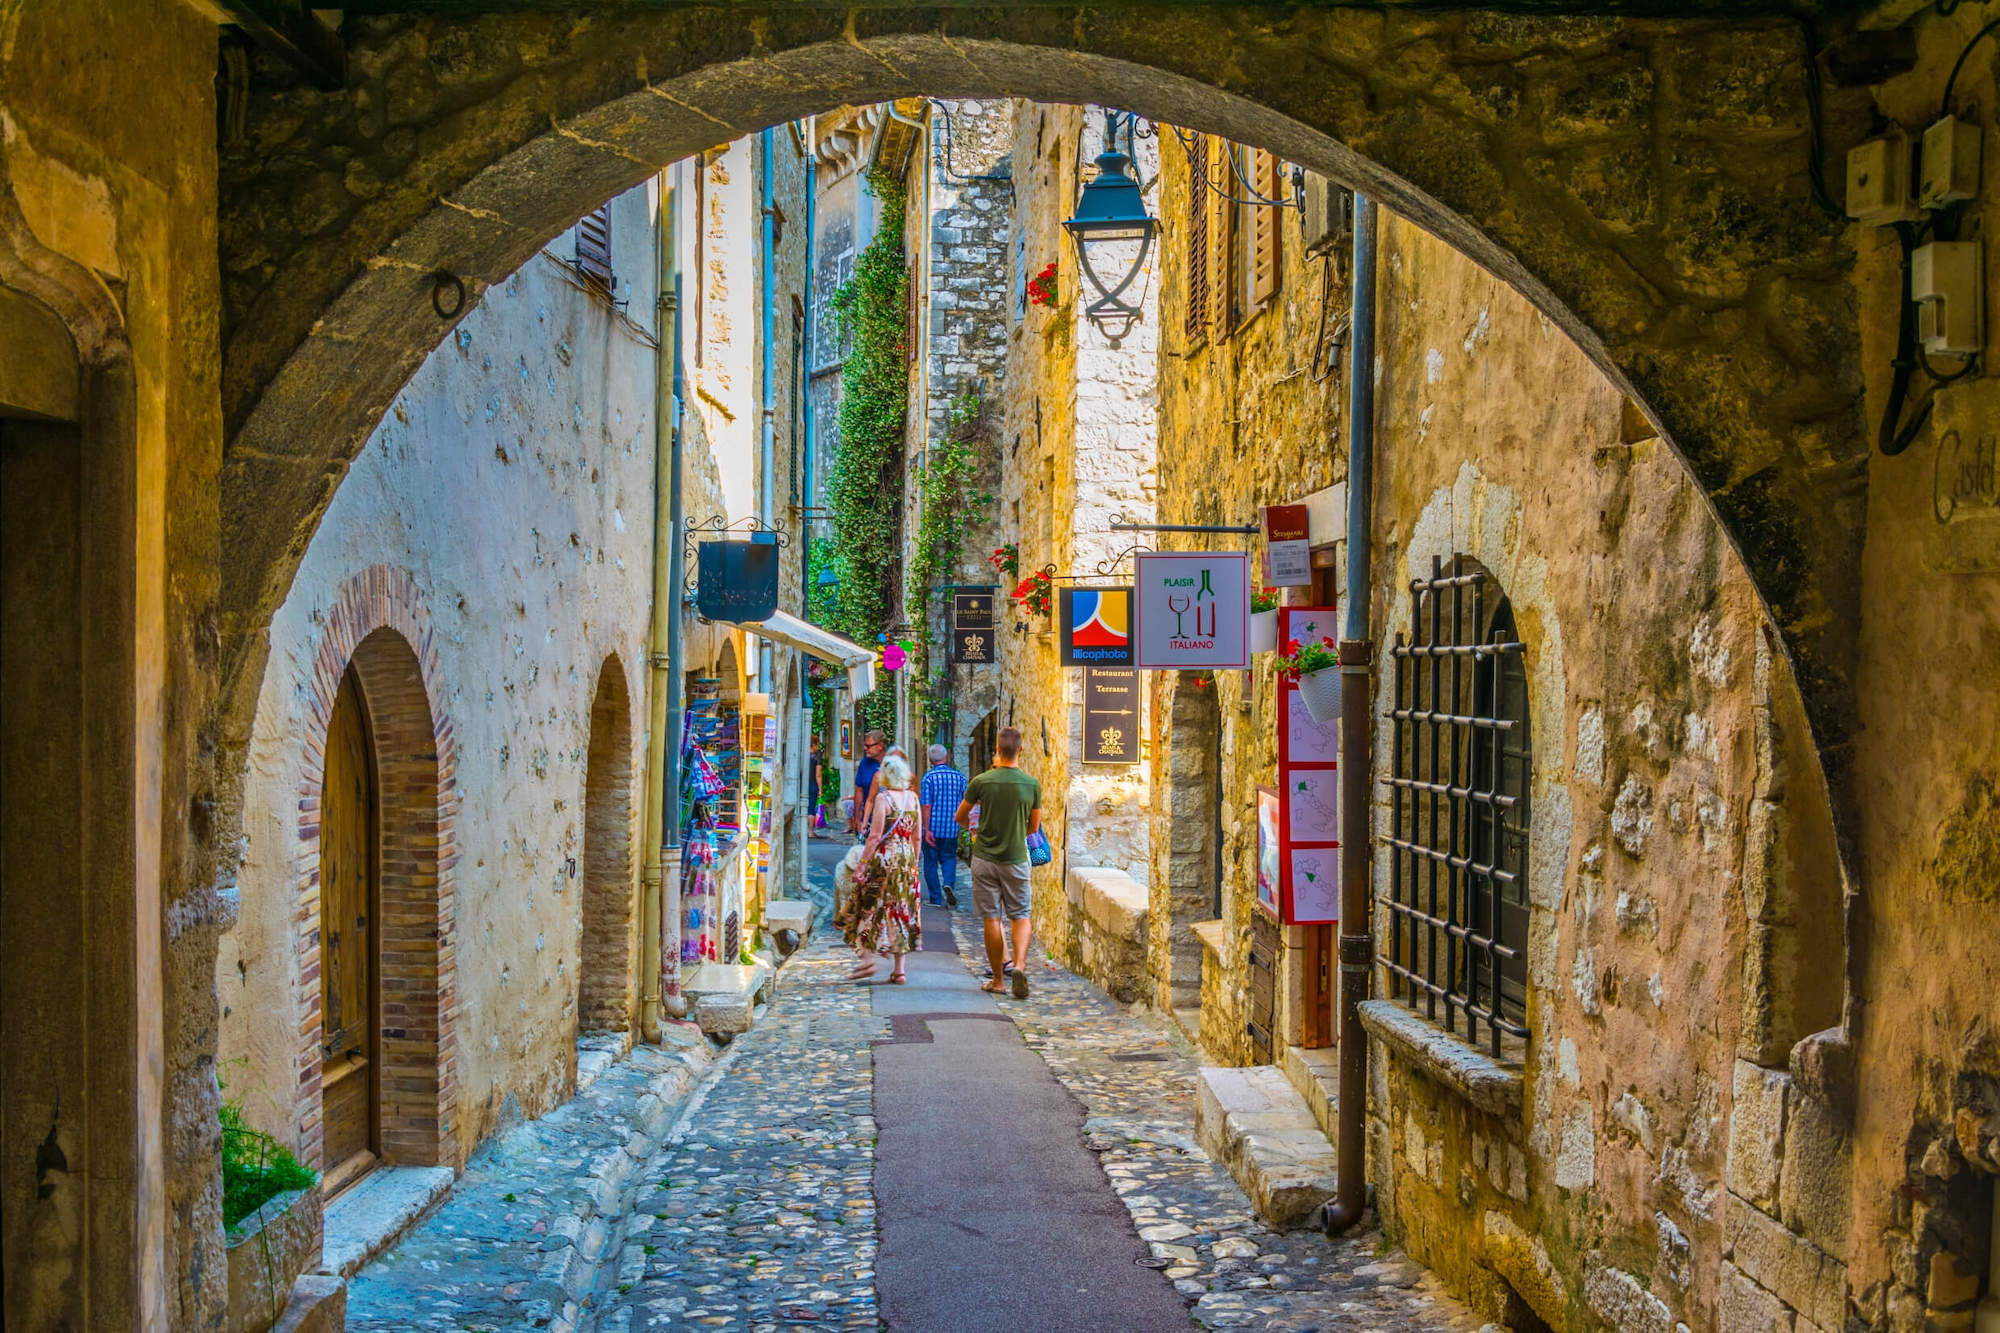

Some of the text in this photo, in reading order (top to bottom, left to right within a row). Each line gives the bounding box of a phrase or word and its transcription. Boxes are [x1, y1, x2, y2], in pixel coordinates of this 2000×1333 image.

[1164, 578, 1195, 587] PLAISIR
[1170, 640, 1214, 649] ITALIANO
[1092, 669, 1134, 677] Restaurant
[1096, 685, 1128, 693] Terrasse
